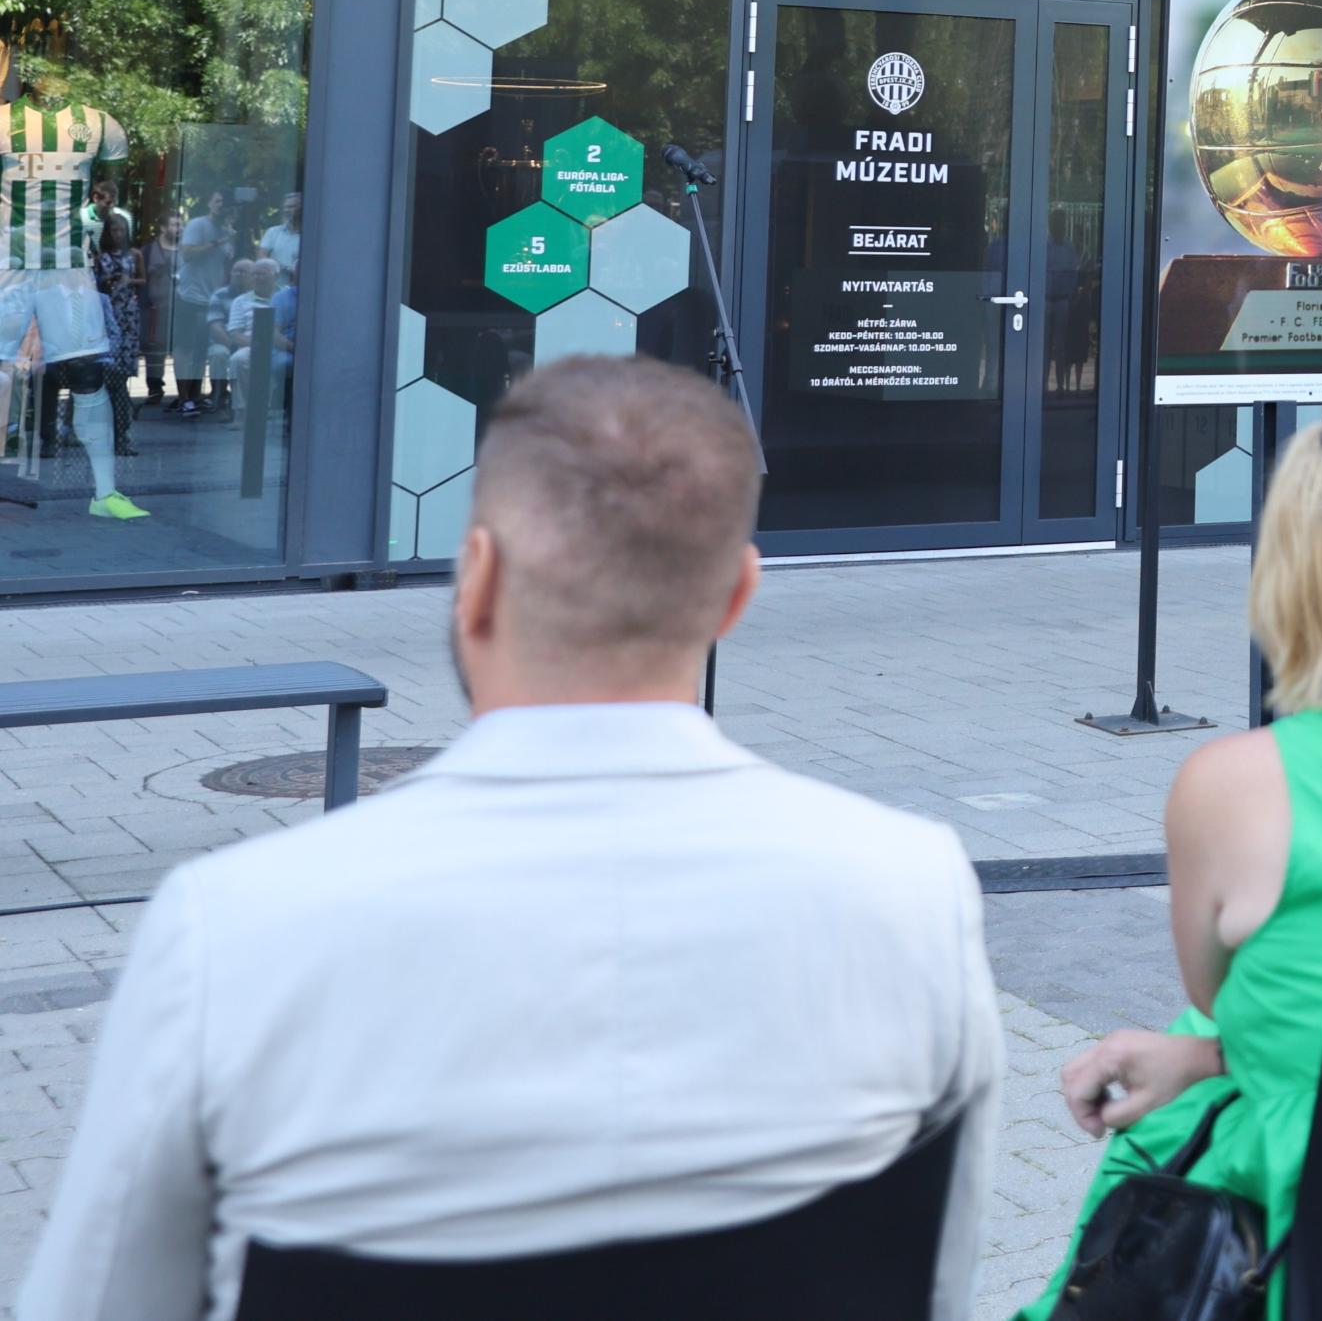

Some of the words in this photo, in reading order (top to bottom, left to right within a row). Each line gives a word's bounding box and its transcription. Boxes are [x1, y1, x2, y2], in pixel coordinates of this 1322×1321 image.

[855, 130, 933, 153] FRADI
[587, 145, 601, 163] 2
[557, 169, 599, 182] EURÓPA
[600, 172, 628, 182] LIGA-
[836, 156, 949, 184] MÚZEUM
[570, 181, 616, 194] FŐTÁBLA
[531, 236, 545, 255] 5
[853, 230, 928, 249] BEJÁRAT
[503, 263, 571, 274] EZÜSTLABDA
[842, 279, 934, 292] NYITVATARTÁS
[889, 318, 917, 328] ZÁRVA
[1241, 331, 1283, 342] Premier
[849, 365, 922, 374] MECCSNAPOKON:
[810, 378, 820, 387] 10
[822, 376, 855, 387] ÓRÁTÓL
[857, 378, 863, 386] A
[865, 376, 911, 386] MÉRKŐZÉS
[912, 376, 958, 386] KEZDETÉIG
